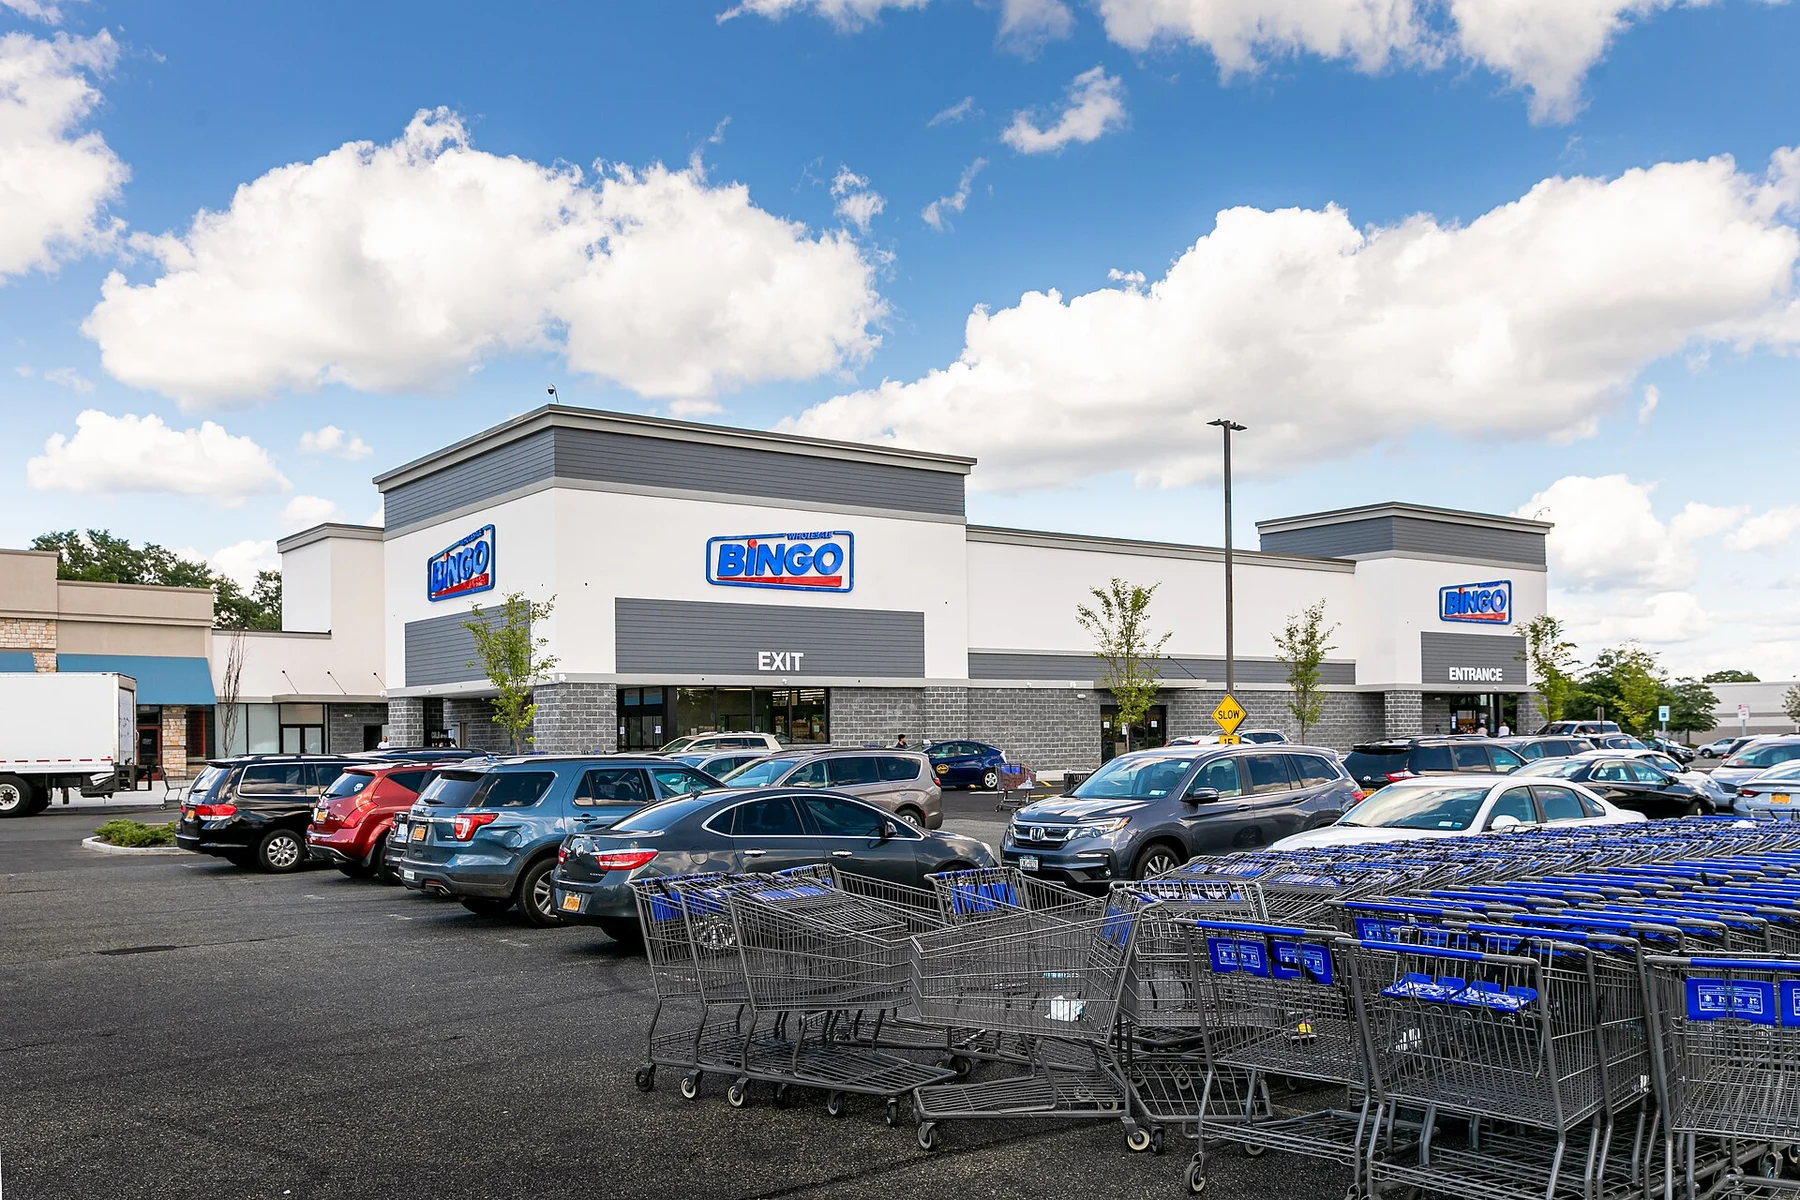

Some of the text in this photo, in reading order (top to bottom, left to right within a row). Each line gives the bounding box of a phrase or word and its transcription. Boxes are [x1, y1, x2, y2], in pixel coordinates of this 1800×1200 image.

[758, 651, 804, 671] EXIT
[1449, 666, 1503, 681] ENTRANCE
[1218, 710, 1240, 720] SLOW
